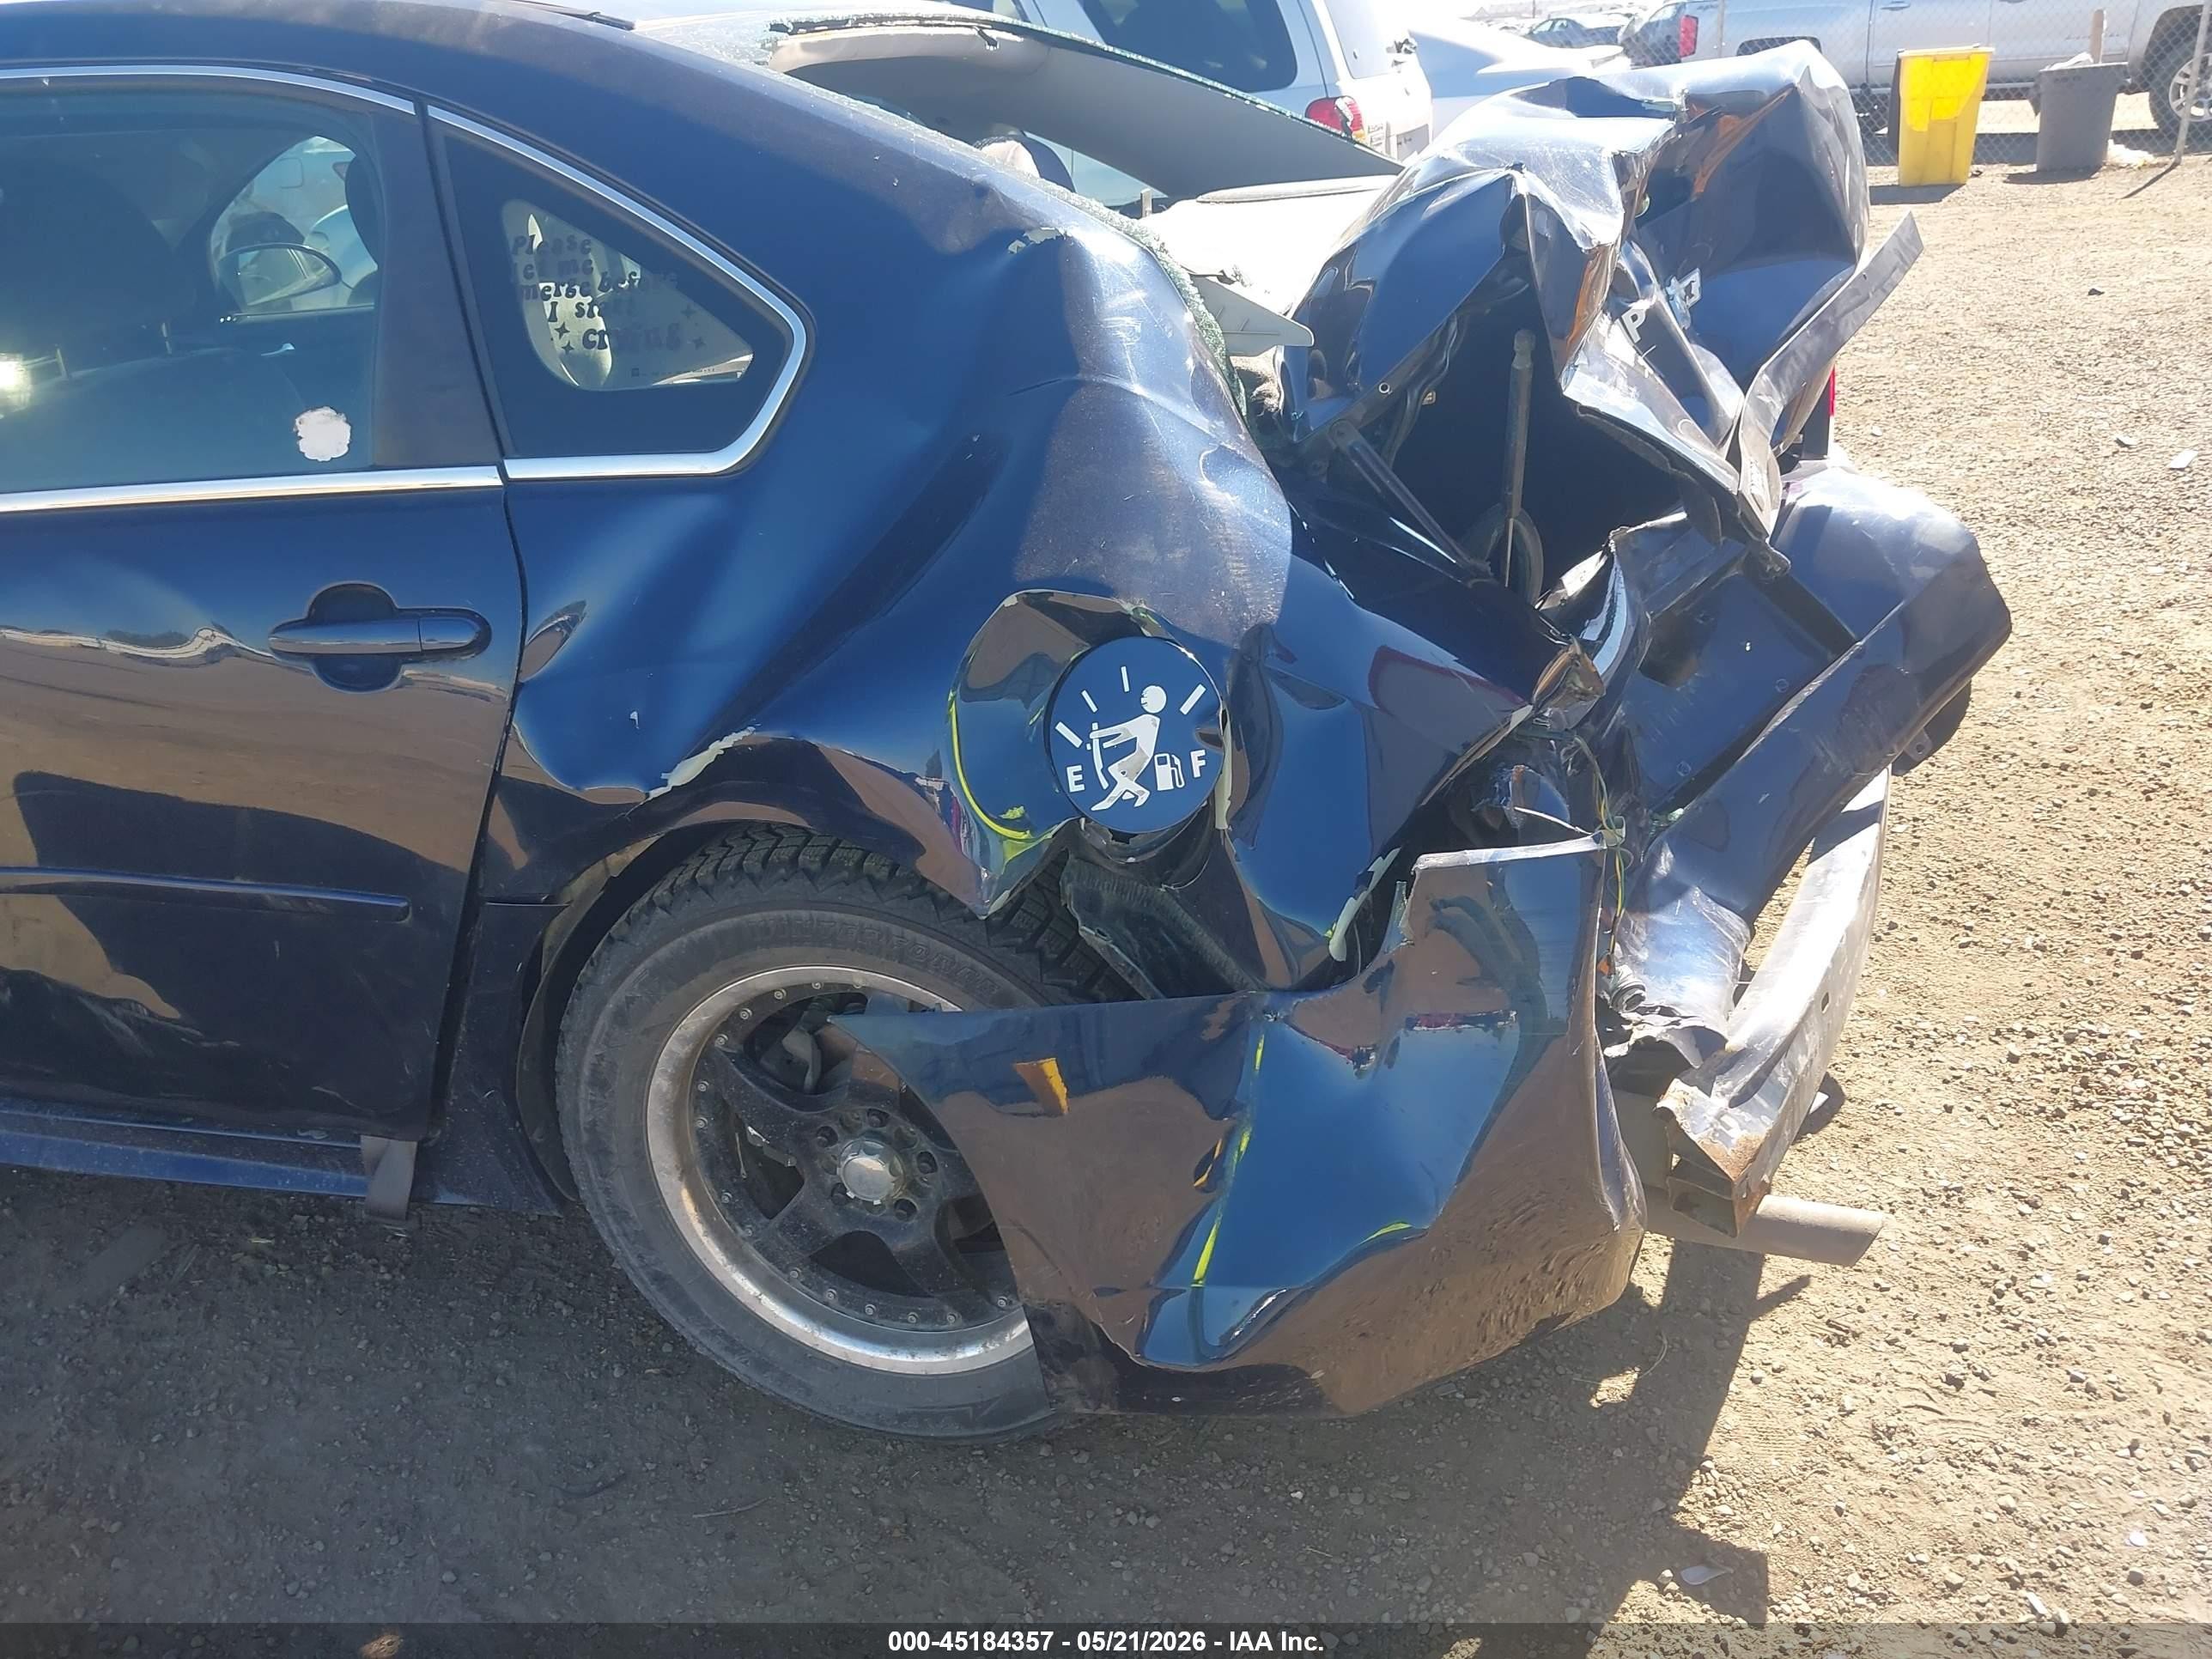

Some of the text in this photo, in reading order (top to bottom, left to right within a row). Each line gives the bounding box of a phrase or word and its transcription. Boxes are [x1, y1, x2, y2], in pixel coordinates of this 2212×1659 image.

[512, 234, 592, 255] Please
[558, 258, 594, 278] me
[521, 278, 592, 301] merge
[548, 301, 559, 322] I
[1190, 749, 1206, 778] F
[1066, 765, 1085, 793] E
